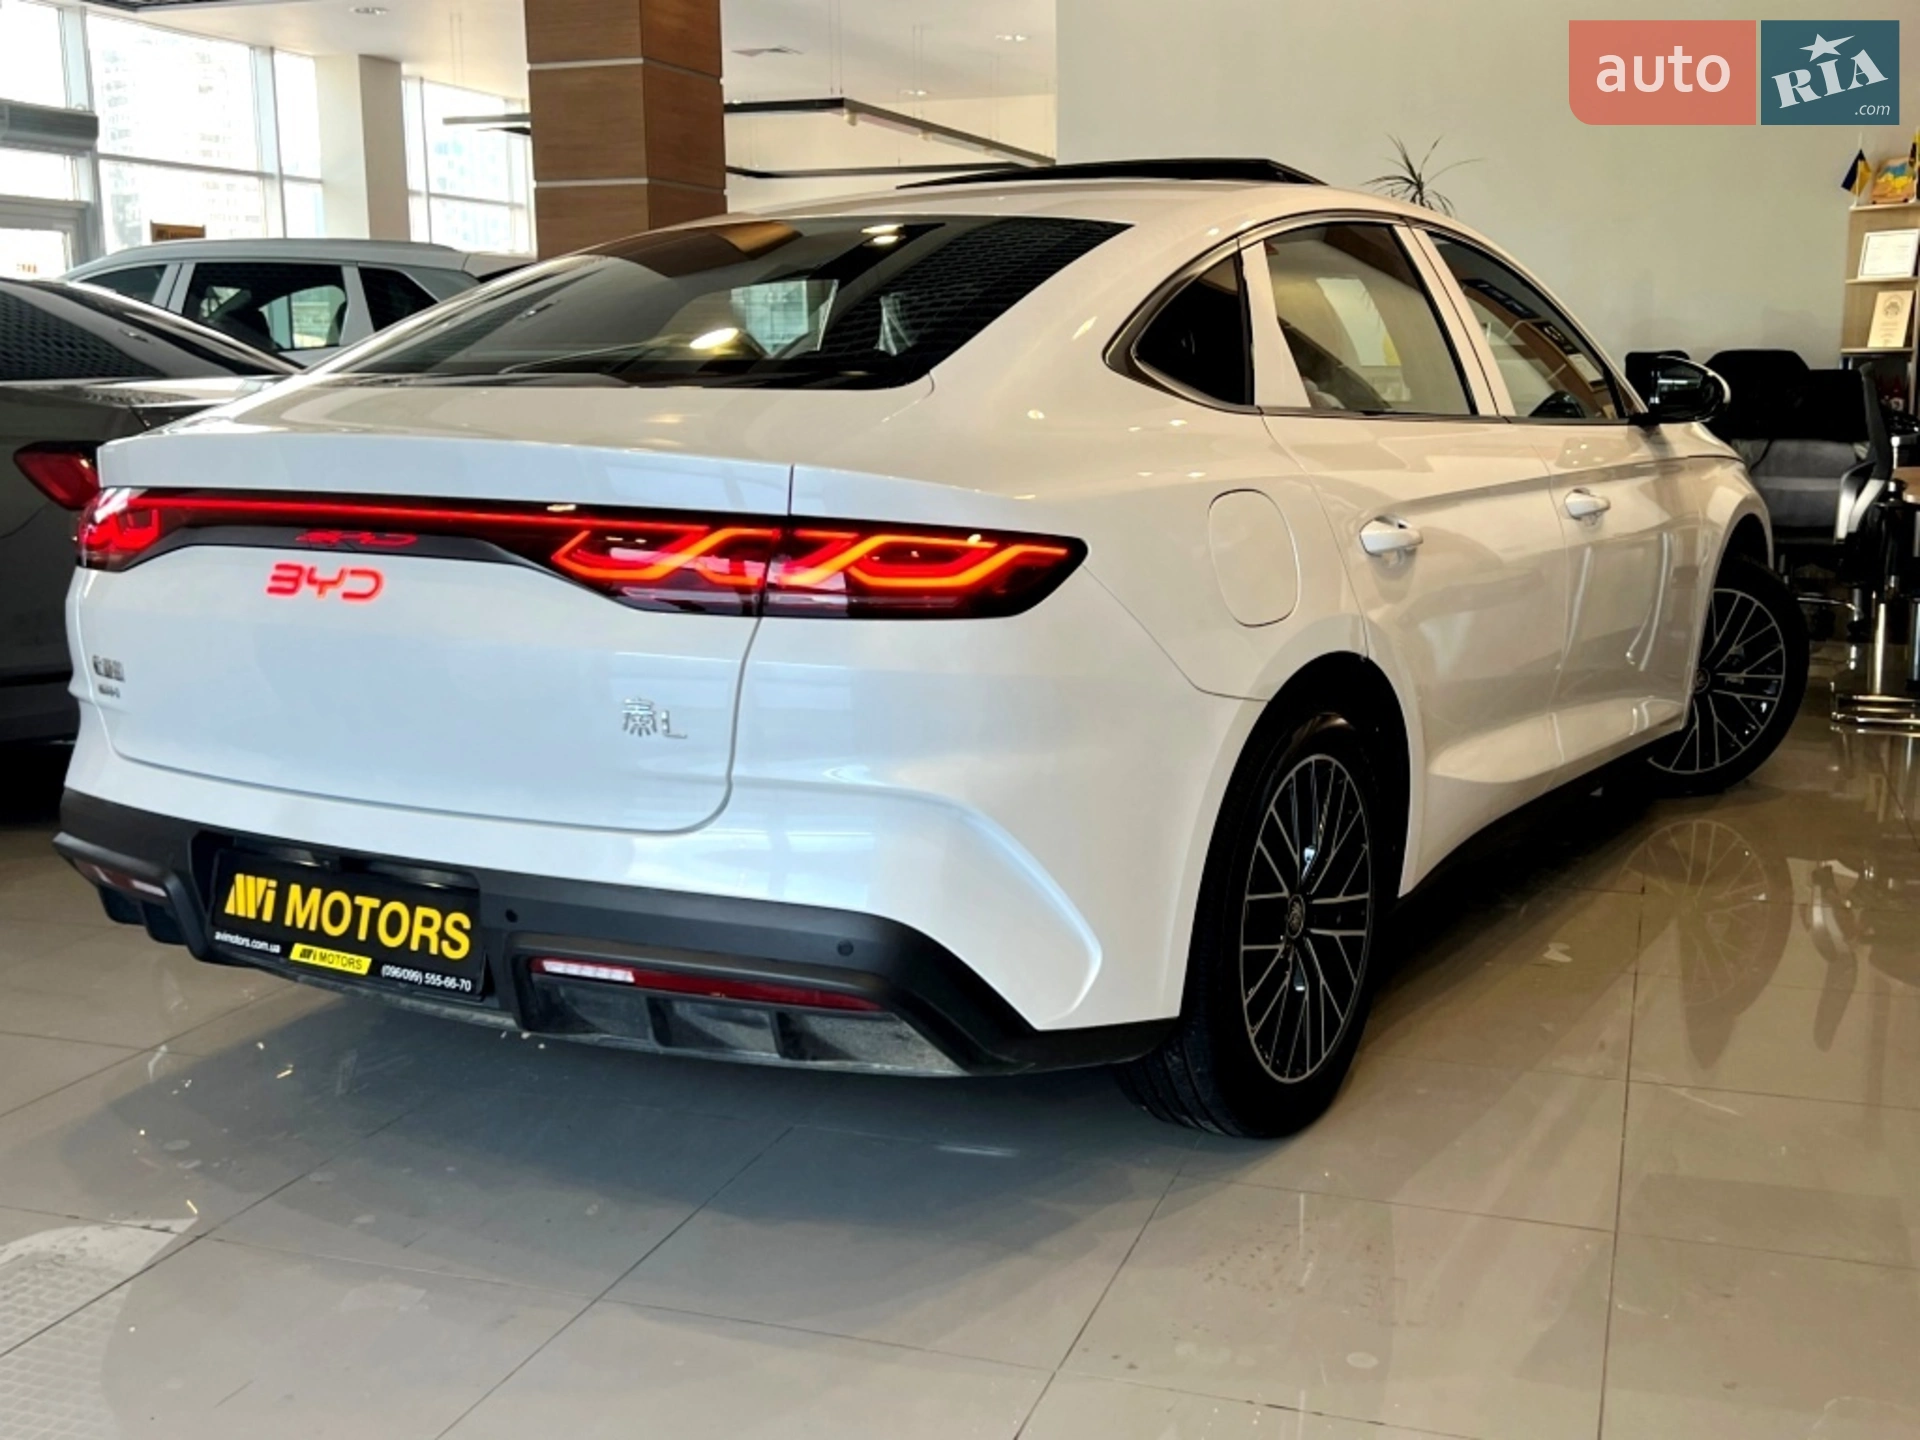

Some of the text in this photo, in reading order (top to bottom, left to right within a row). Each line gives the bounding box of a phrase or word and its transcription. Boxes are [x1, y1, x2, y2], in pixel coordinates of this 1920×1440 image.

[267, 562, 384, 601] BYD
[284, 883, 472, 960] MOTORS
[319, 952, 363, 970] MOTORS
[424, 972, 472, 992] 555-66-70
